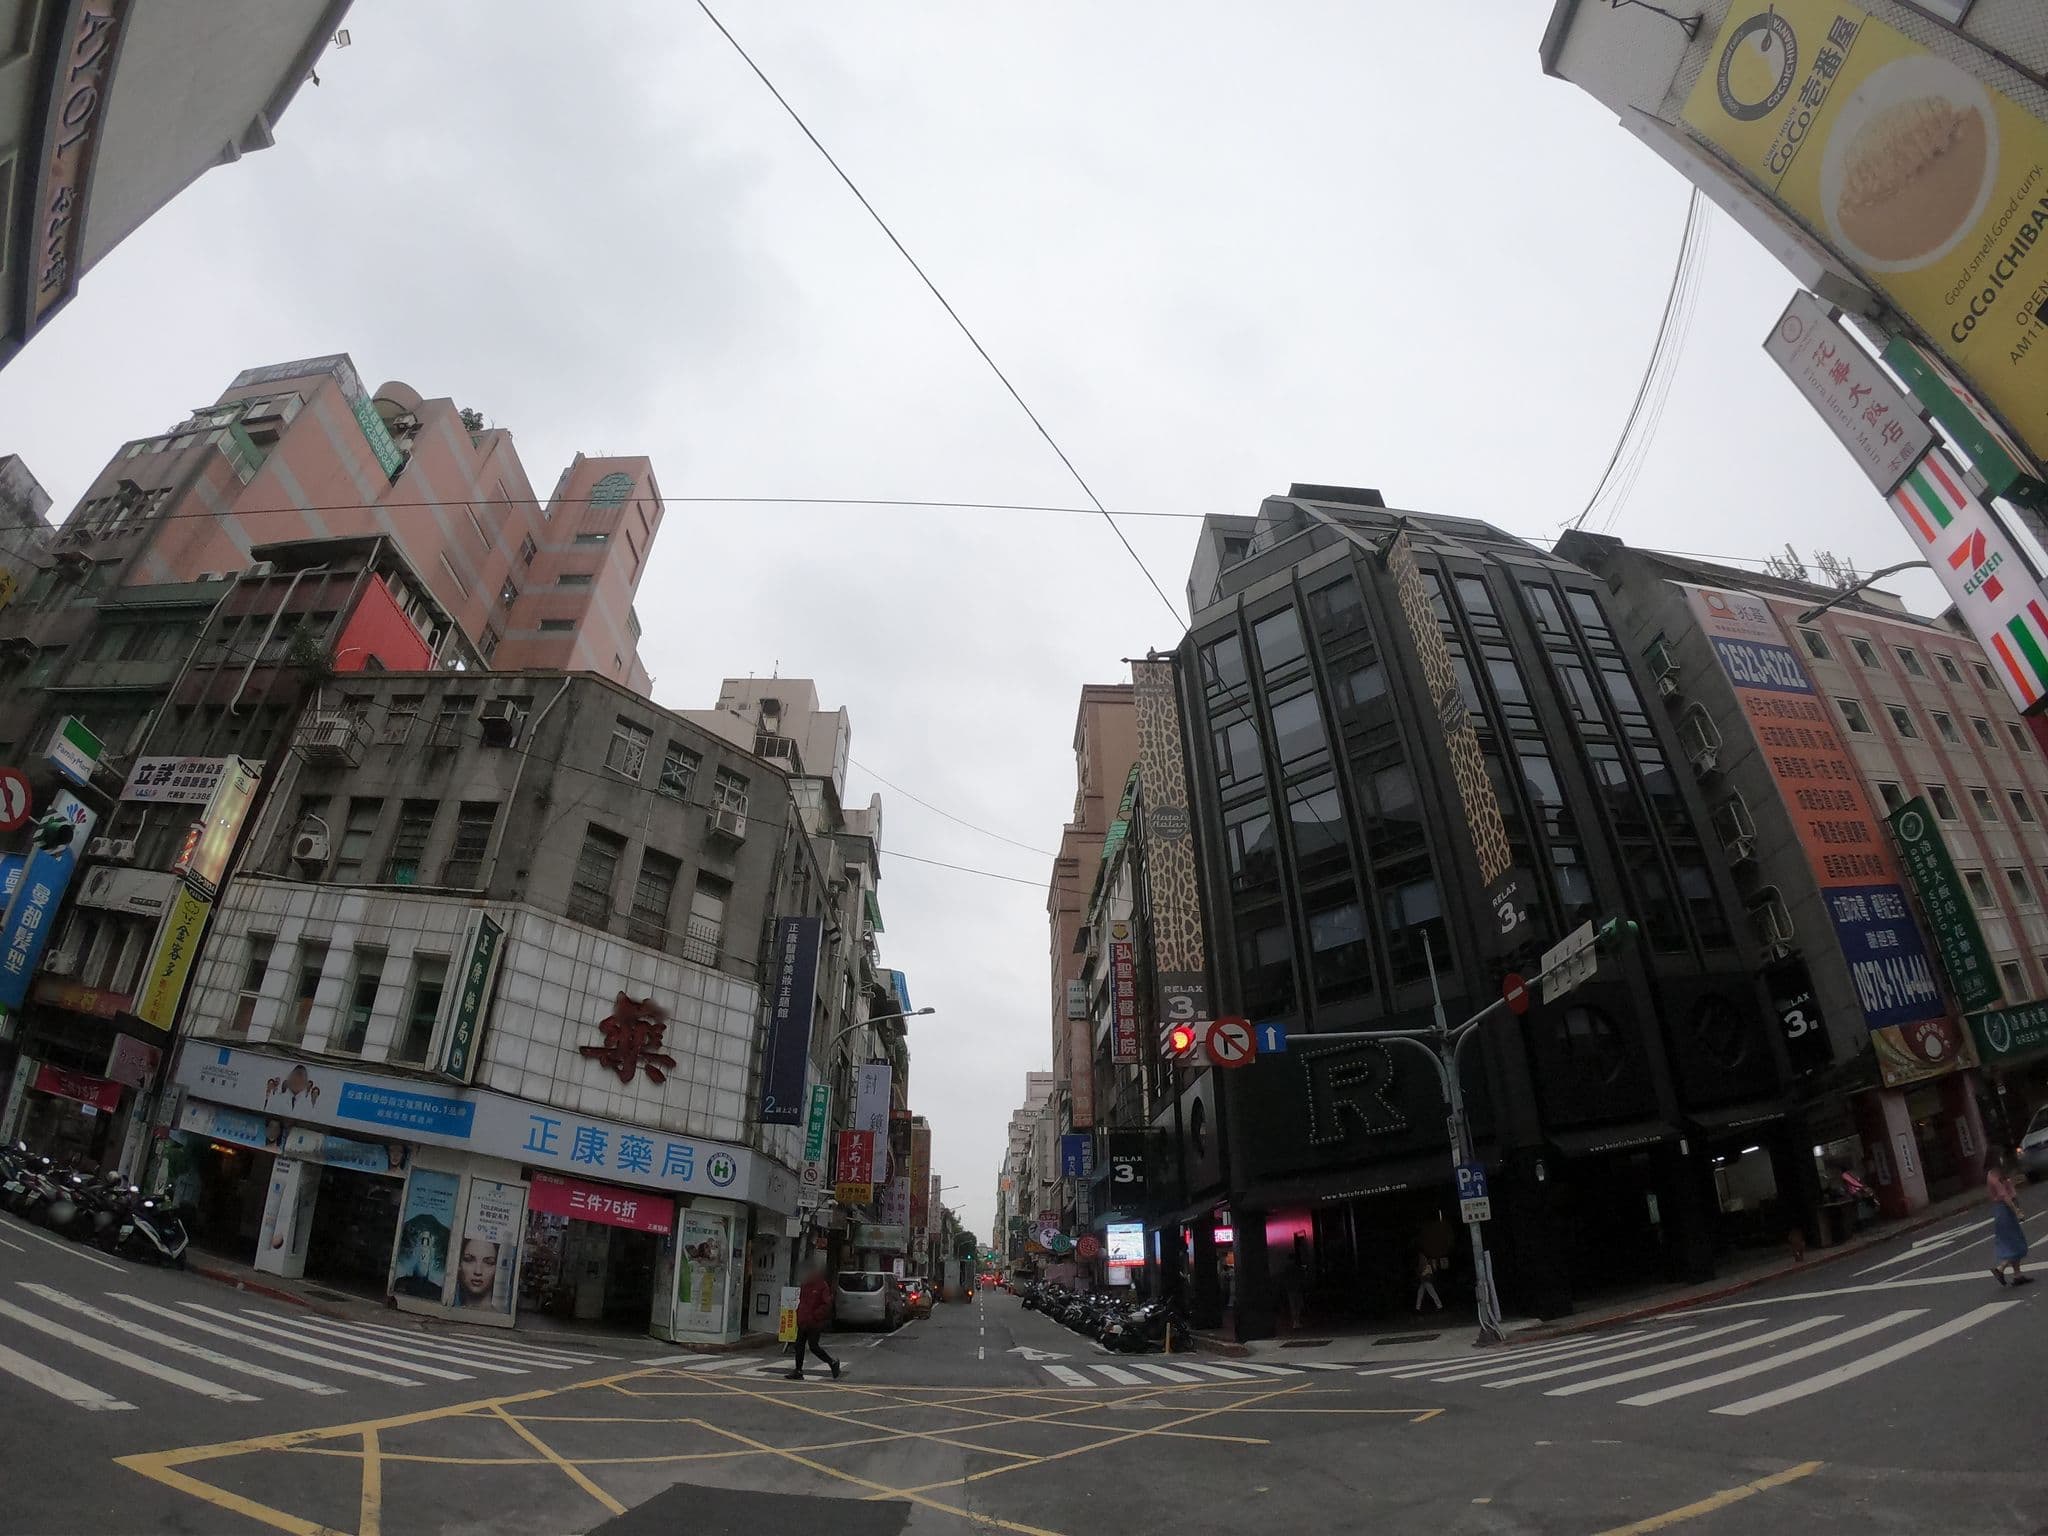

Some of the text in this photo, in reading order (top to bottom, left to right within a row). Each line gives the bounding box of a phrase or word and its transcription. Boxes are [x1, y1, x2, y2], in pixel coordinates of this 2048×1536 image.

[1944, 267, 1972, 306] Good
[1812, 340, 1904, 447] 花華大飯店
[1719, 642, 1809, 690] 2523-6222
[56, 742, 92, 774] FamilyMart
[1492, 881, 1517, 907] RELAX
[1909, 847, 1930, 885] GREEN
[1929, 891, 1947, 931] WORLD
[1164, 985, 1204, 993] RELAX
[1789, 993, 1810, 1006] LAX
[1300, 1040, 1408, 1145] R
[522, 1114, 697, 1184] 正康藥局
[1112, 1155, 1143, 1163] RELAX
[569, 1190, 638, 1219] 三件75折
